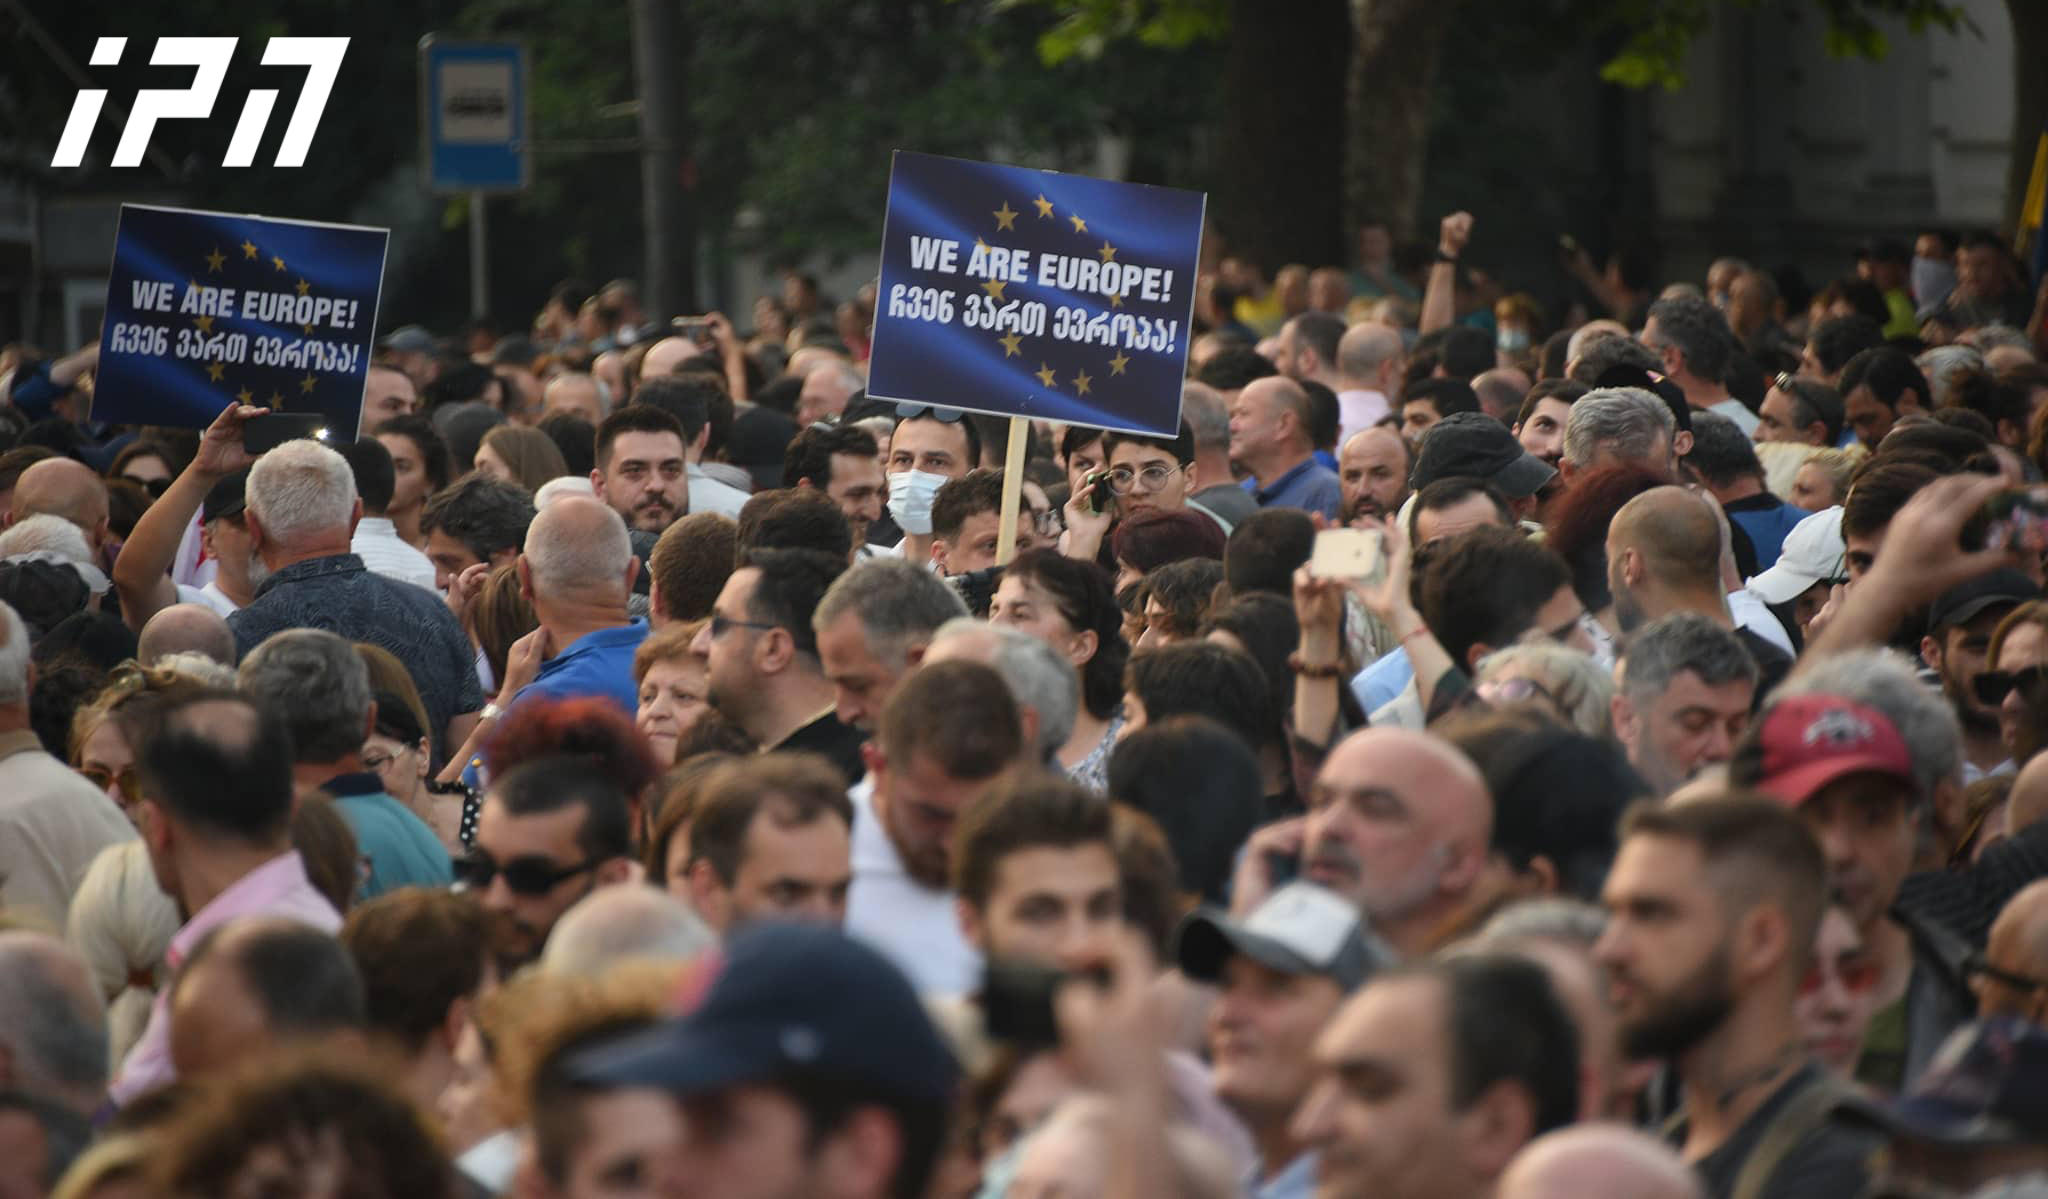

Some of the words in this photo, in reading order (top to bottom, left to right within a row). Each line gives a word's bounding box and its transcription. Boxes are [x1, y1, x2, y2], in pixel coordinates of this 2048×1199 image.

[909, 235, 960, 274] WE
[965, 243, 1030, 283] ARE
[1037, 253, 1174, 303] EUROPE!
[131, 279, 174, 311] WE
[180, 284, 236, 318] ARE
[241, 290, 358, 329] EUROPE!
[888, 283, 956, 324] ჩვენ
[962, 293, 1047, 337] ვართ
[1052, 305, 1178, 354] ევროპა!
[110, 322, 169, 356] ჩვენ
[175, 329, 248, 364] ვართ
[252, 336, 360, 373] ევროპა!
